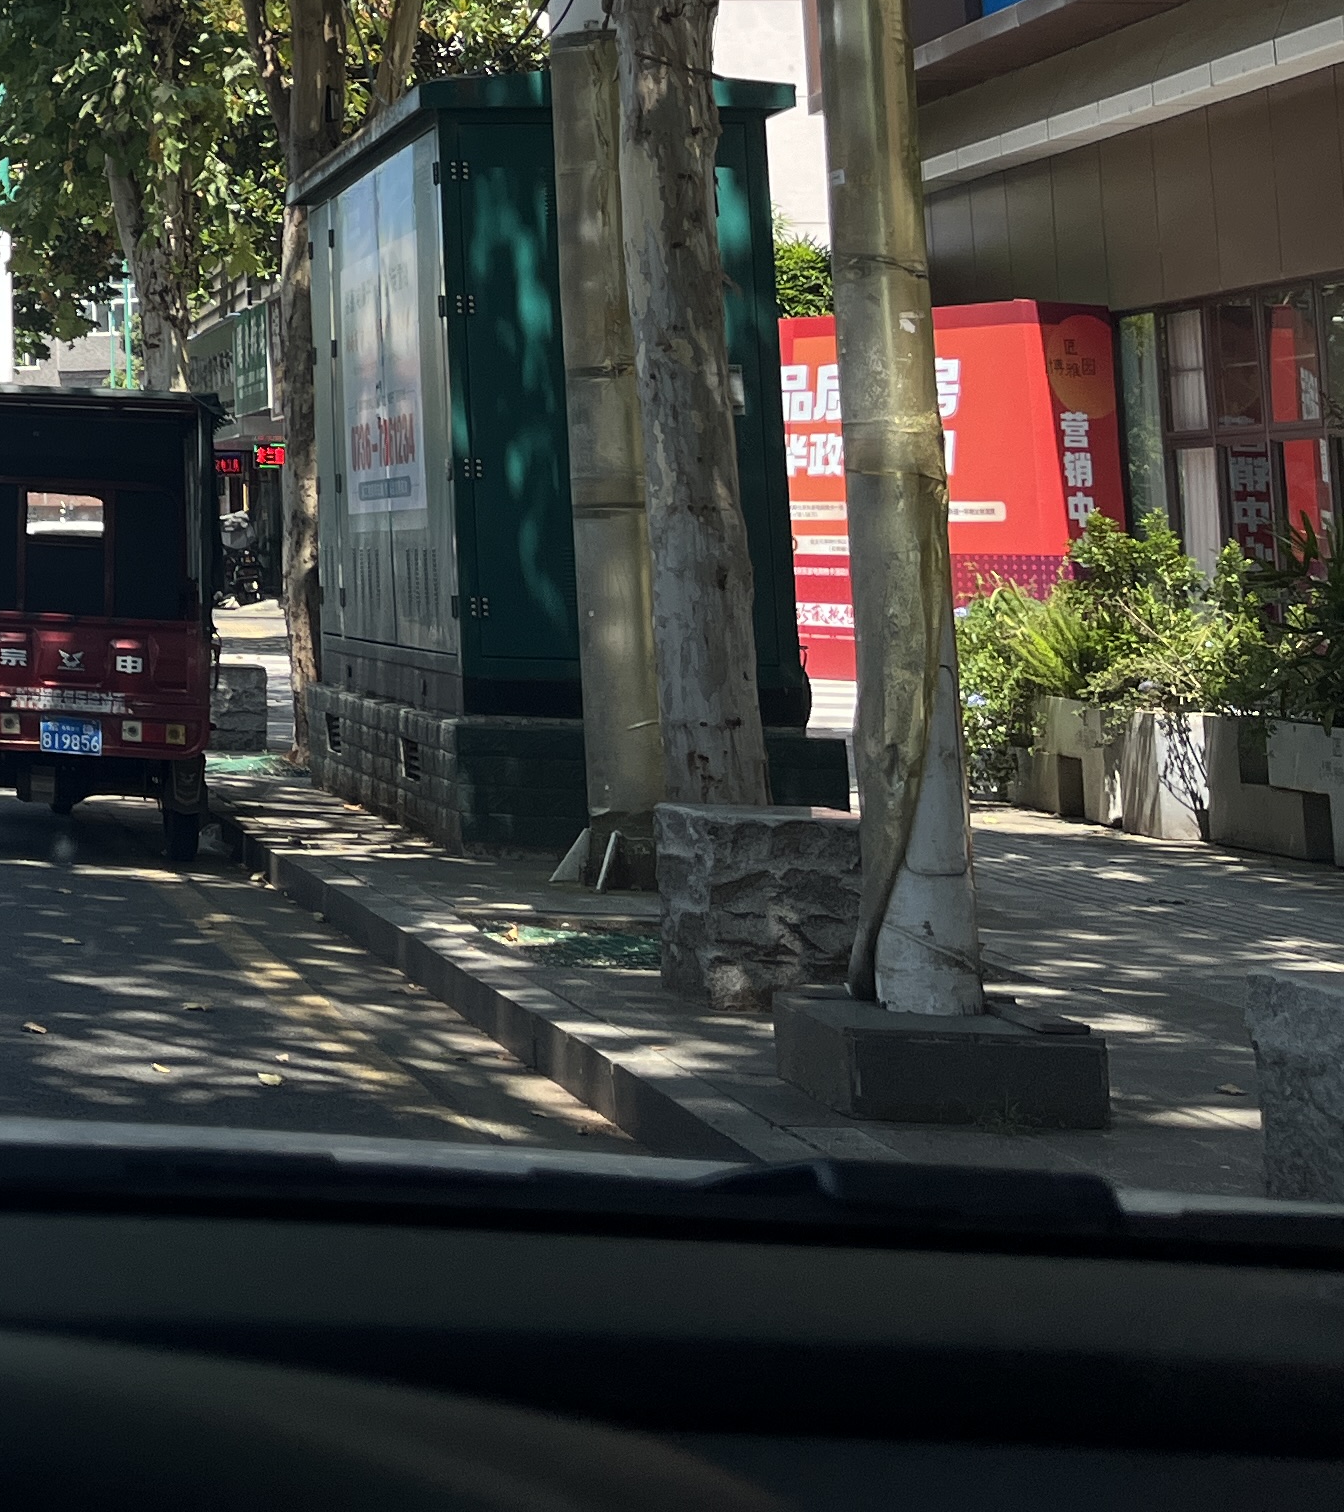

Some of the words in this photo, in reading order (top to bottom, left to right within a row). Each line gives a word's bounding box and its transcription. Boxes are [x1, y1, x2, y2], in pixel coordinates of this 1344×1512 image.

[0, 647, 27, 667] 宗
[115, 654, 144, 675] 申
[42, 731, 100, 752] 819856
